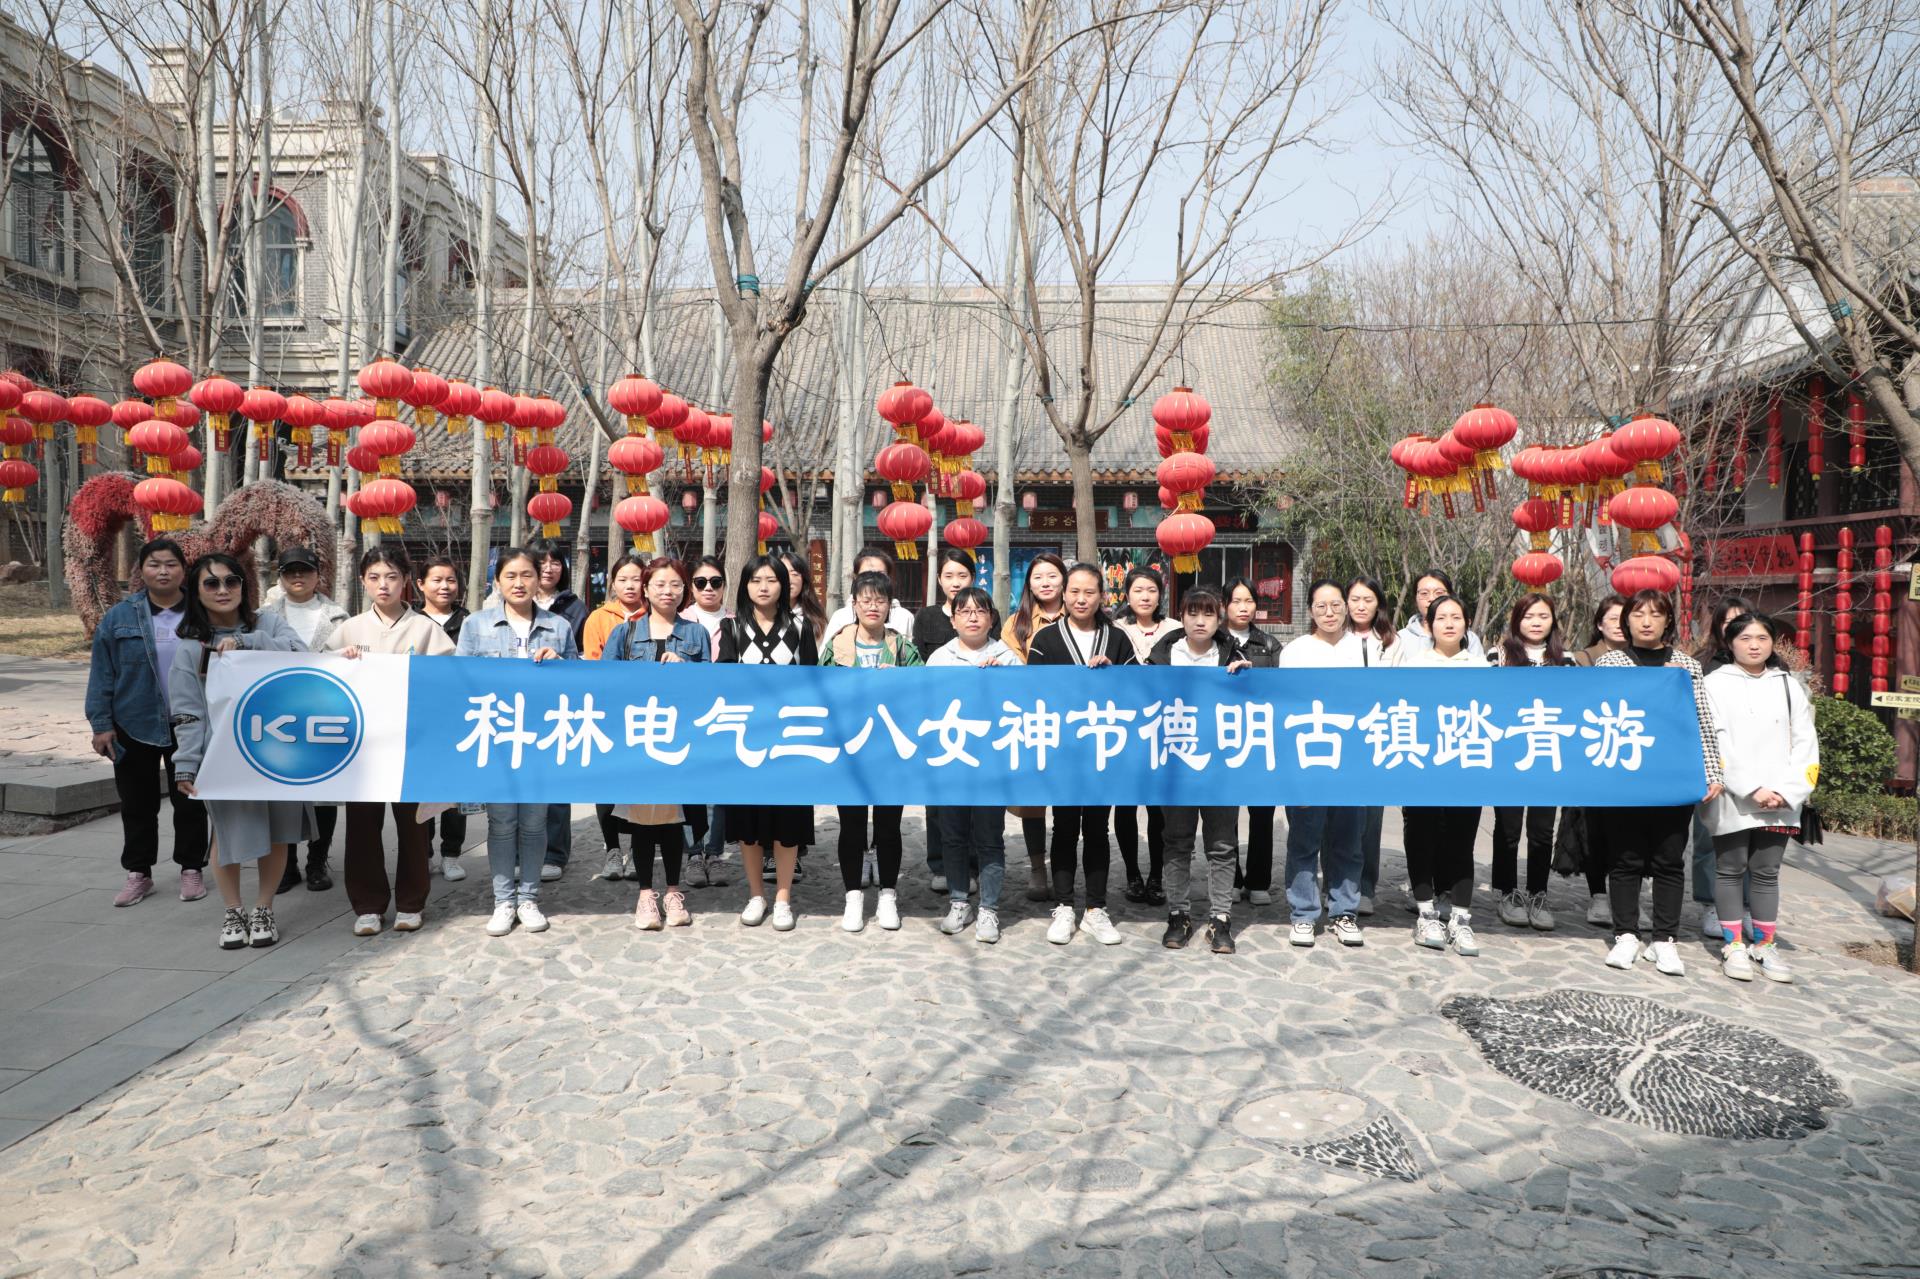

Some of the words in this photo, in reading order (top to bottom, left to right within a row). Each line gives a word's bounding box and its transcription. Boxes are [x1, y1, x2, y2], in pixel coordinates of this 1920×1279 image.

[250, 714, 350, 744] KE
[456, 691, 1656, 773] 科林电气三八女神节德明古镇踏青游
